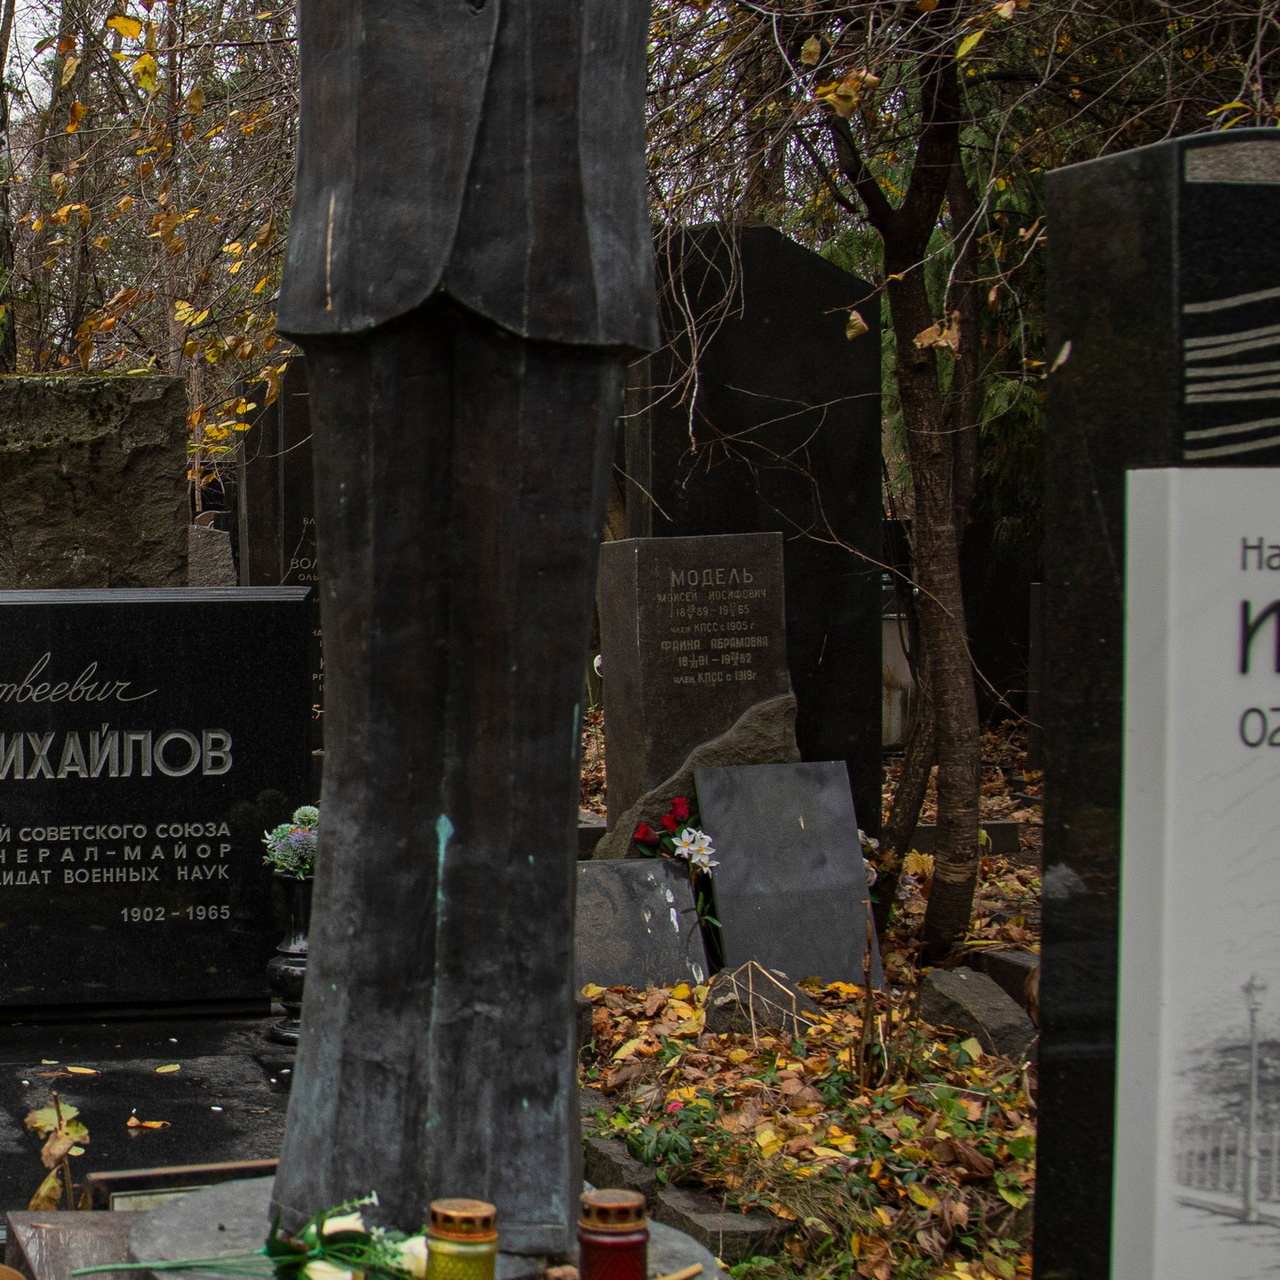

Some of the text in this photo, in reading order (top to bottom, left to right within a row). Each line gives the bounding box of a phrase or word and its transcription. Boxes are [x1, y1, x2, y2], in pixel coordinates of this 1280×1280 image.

[670, 567, 754, 588] МОДЕЛЬ
[656, 588, 767, 603] МОИСЕЙ ИОСИФОВИЧ
[693, 622, 719, 632] КПСС
[660, 636, 768, 651] ФАИНА АБРАМОВНА
[696, 672, 723, 683] КПСС
[19, 824, 148, 843] СОВЕТСКОГО
[155, 821, 231, 839] СОЮЗА
[63, 866, 160, 884] ВОЕННЫХ
[177, 864, 230, 882] НАУК
[120, 907, 166, 922] 1902
[185, 905, 231, 920] 1965
